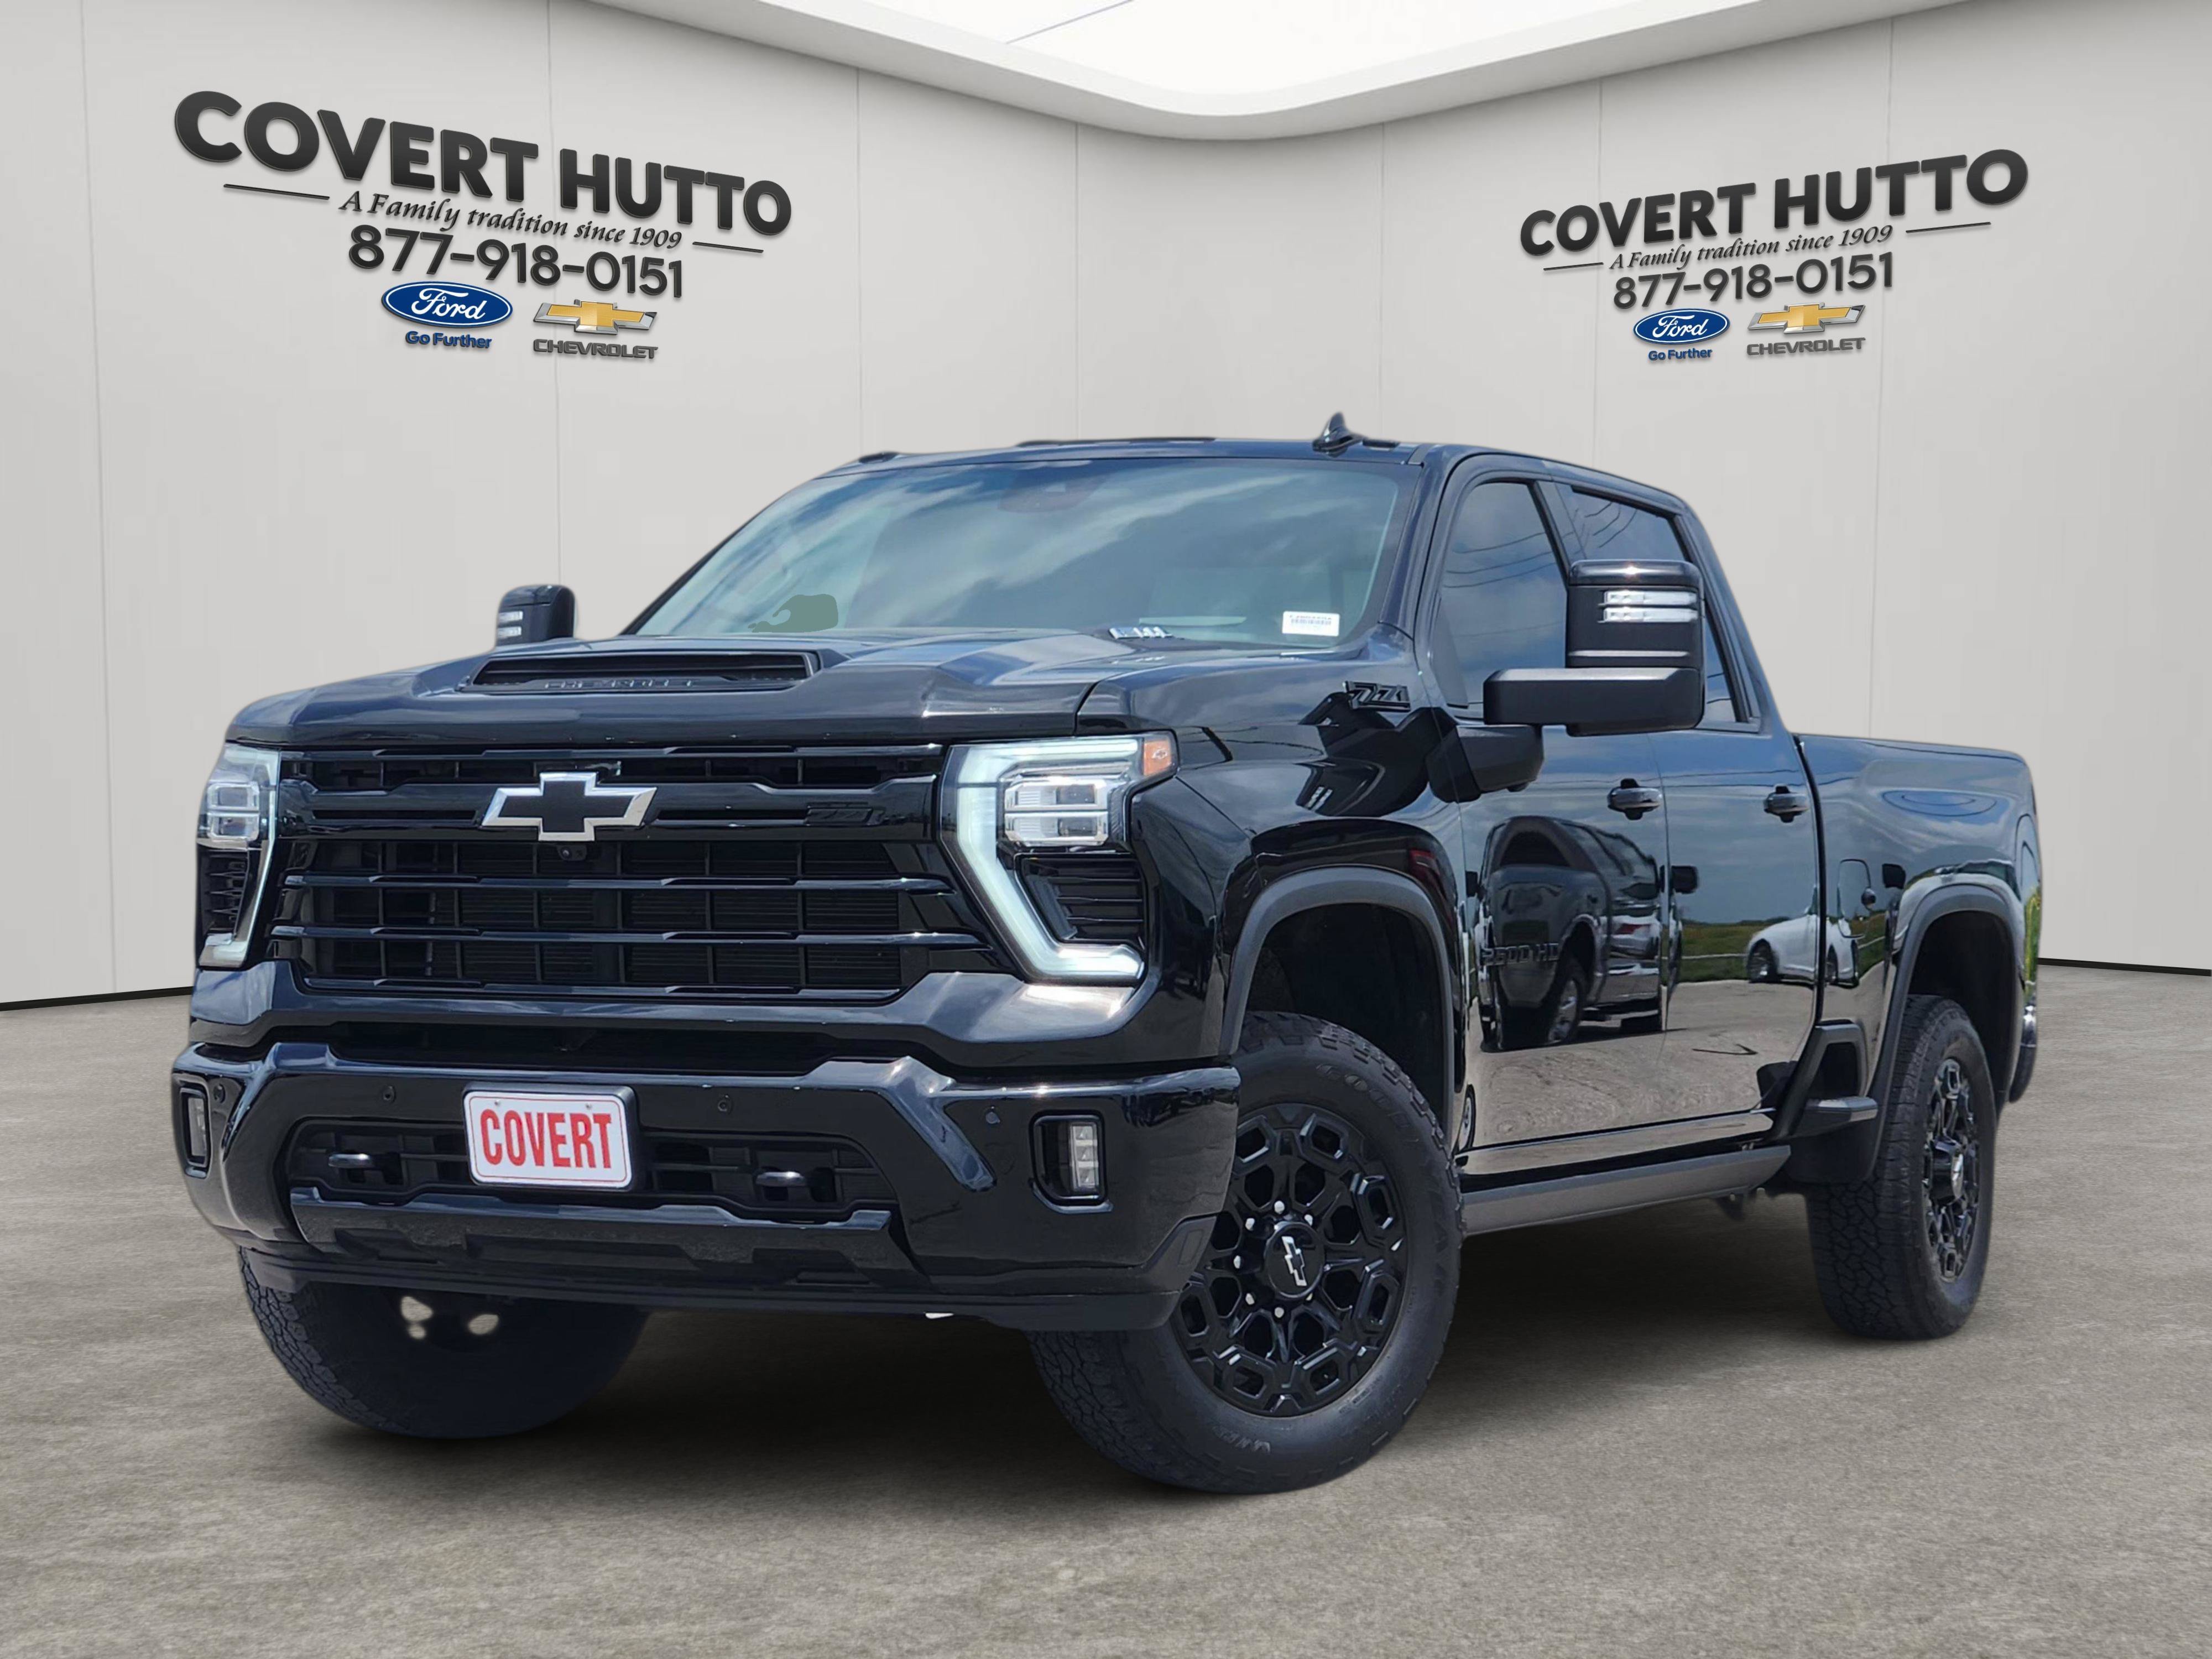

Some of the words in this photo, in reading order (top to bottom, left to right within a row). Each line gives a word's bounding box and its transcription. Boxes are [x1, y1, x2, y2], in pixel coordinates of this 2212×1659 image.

[174, 91, 539, 203] COVERT
[560, 148, 791, 237] HUTTO
[338, 190, 362, 212] A
[367, 193, 461, 232] Family
[467, 207, 568, 236] tradition
[573, 221, 625, 243] since
[629, 227, 682, 249] 1909
[1520, 182, 1756, 257] COVERT
[1774, 149, 2028, 230] HUTTO
[348, 225, 682, 299] 877-918-0151
[1609, 253, 1624, 270] A
[1626, 243, 1692, 270] Family
[1697, 237, 1780, 261] tradition
[1785, 235, 1834, 252] since
[1838, 225, 1893, 247] 1909
[1614, 251, 1892, 310] 877-918-0151
[411, 288, 487, 320] Ford
[1652, 315, 1709, 338] Ford
[405, 331, 431, 347] Go
[432, 332, 492, 349] Further
[533, 338, 659, 359] CHEVROLET
[1648, 350, 1666, 361] Go
[1667, 347, 1713, 360] Further
[1746, 337, 1866, 356] CHEVROLET
[479, 1108, 612, 1169] COVERT
